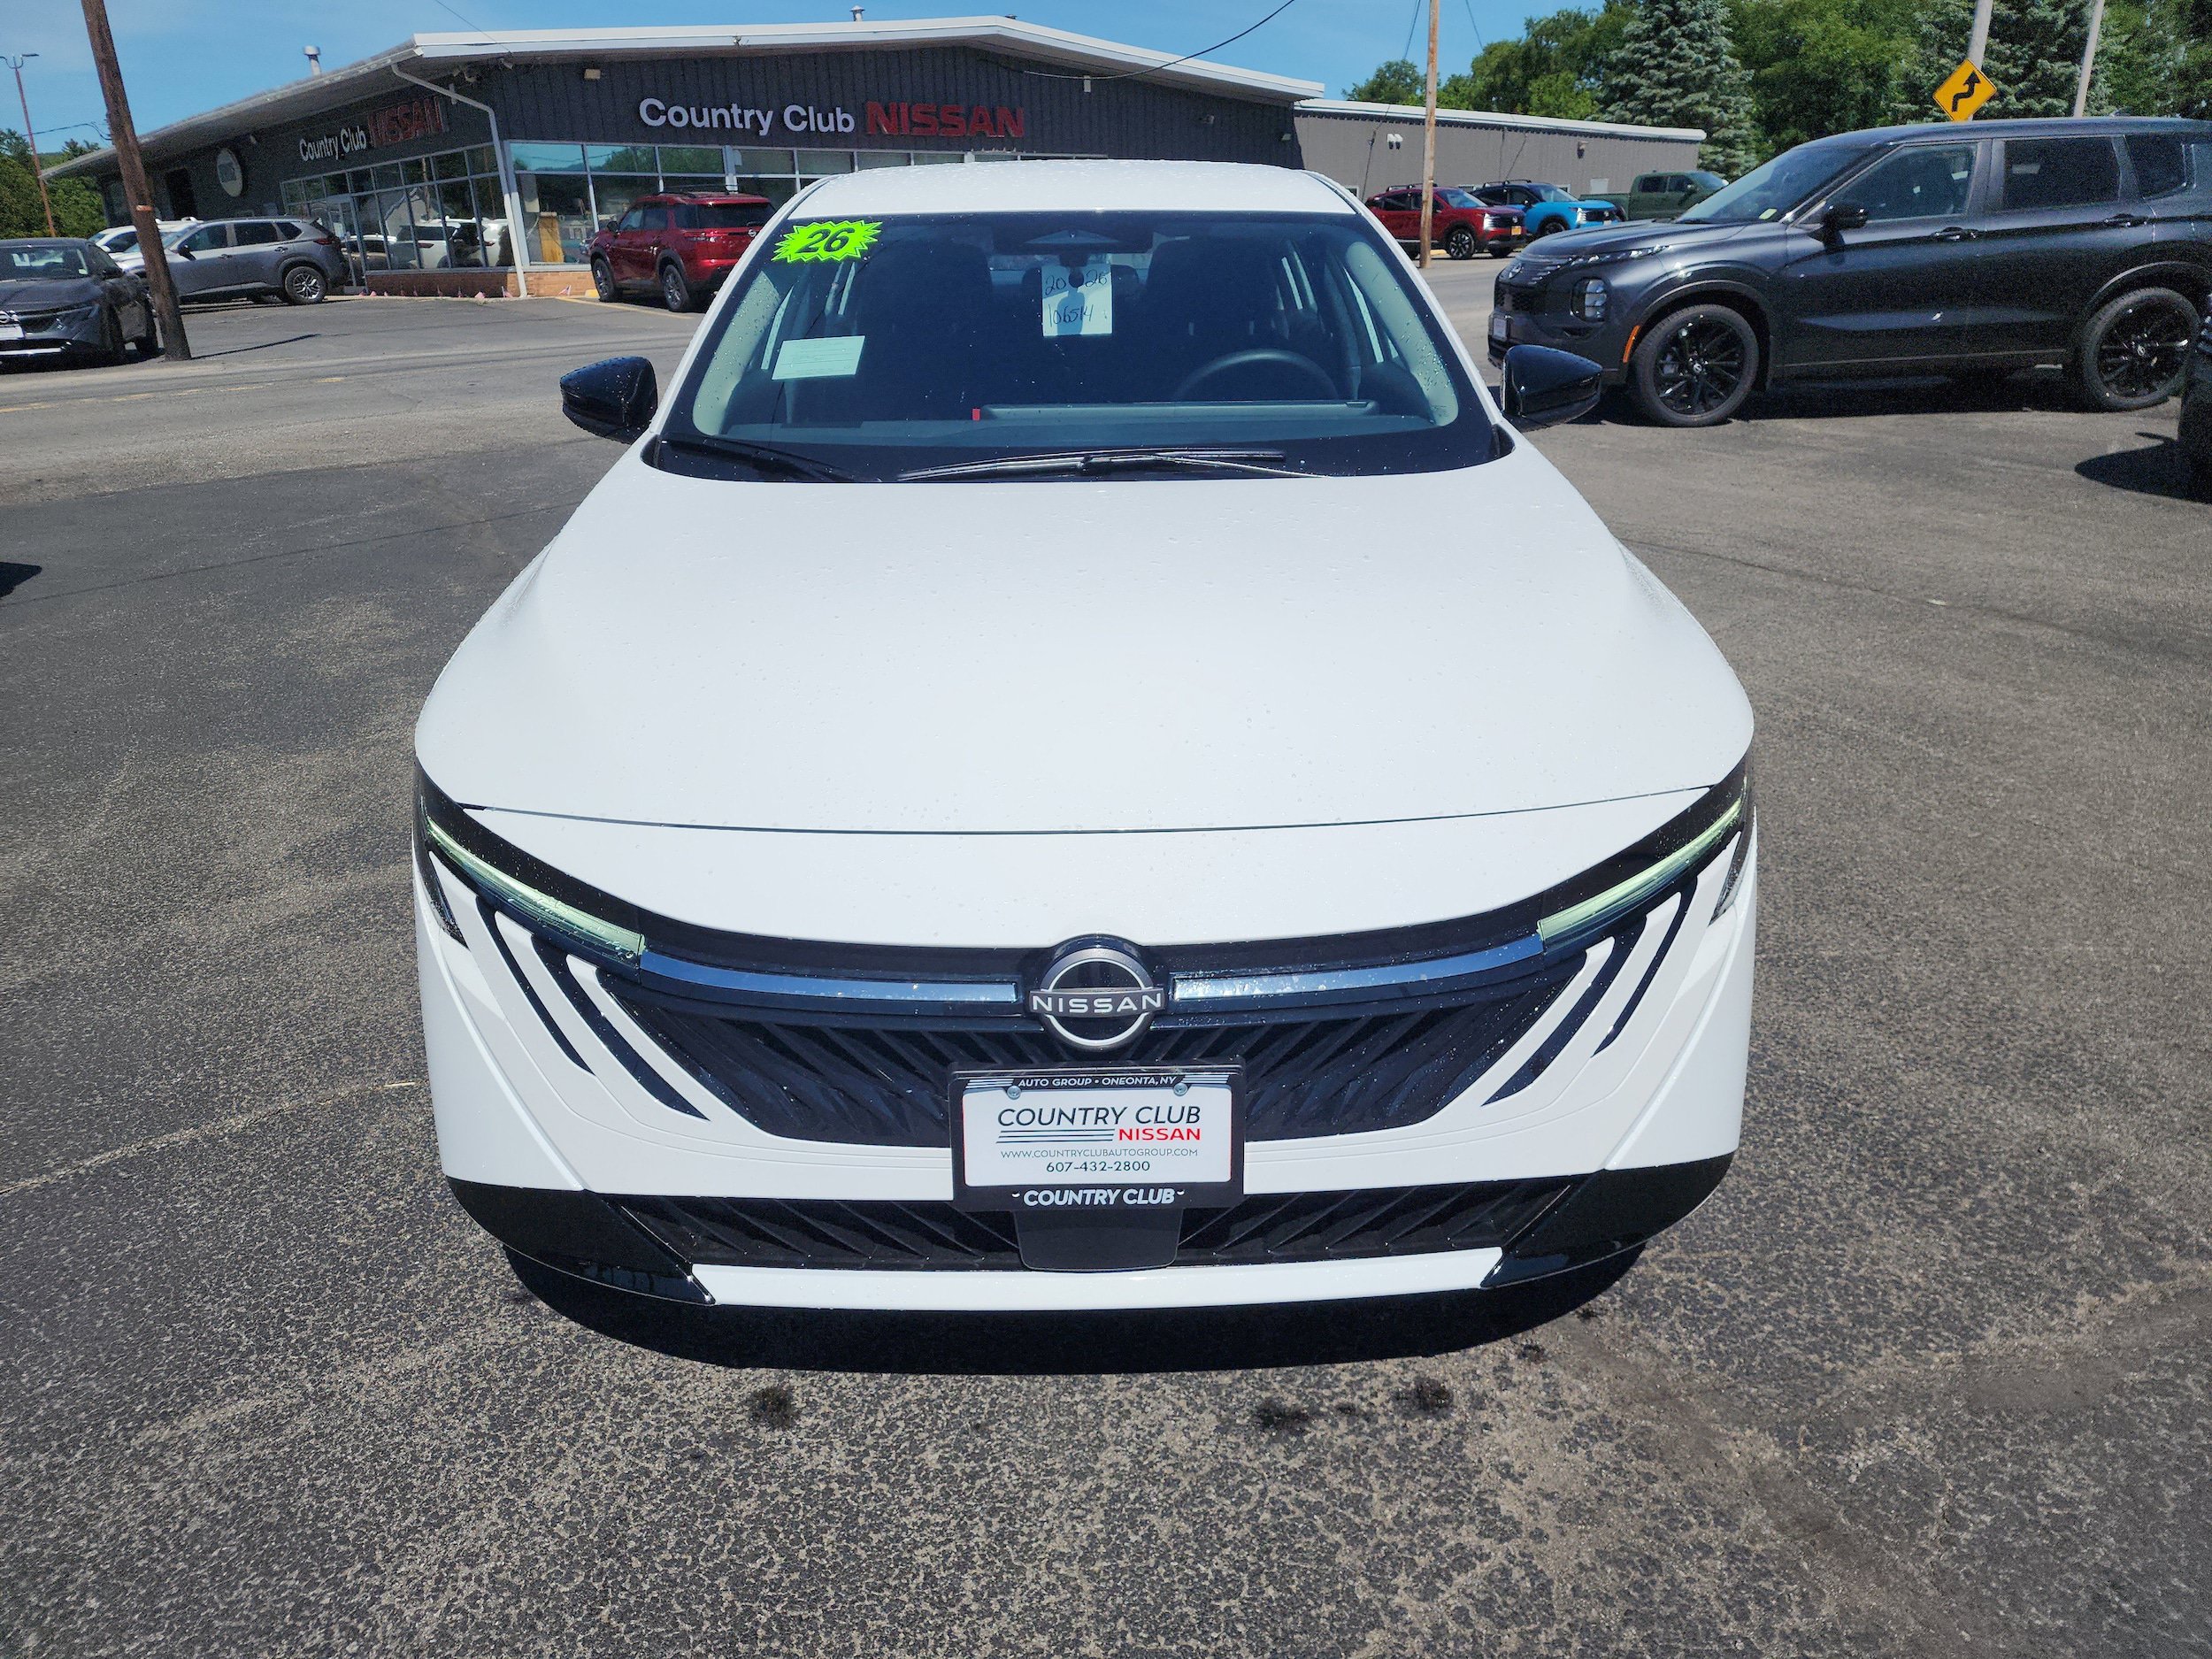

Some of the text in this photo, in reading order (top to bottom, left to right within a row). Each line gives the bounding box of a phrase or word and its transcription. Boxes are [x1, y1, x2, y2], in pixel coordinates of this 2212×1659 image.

[639, 97, 1025, 138] Country Club NISSAN
[299, 96, 442, 161] Country Club NISSAN
[796, 227, 856, 254] 26
[1045, 268, 1108, 296] 20 26
[1033, 993, 1161, 1013] NISSAN
[1018, 1078, 1049, 1087] AUTO
[1052, 1078, 1092, 1087] GROUP
[998, 1105, 1202, 1126] COUNTRY CLUB
[1118, 1127, 1202, 1141] NISSAN
[1001, 1148, 1199, 1159] WWW.COUNTRYCLUBAUTOGROUP.COM
[1046, 1160, 1151, 1173] 607-432-2800
[1023, 1187, 1176, 1207] COUNTRY CLUB
